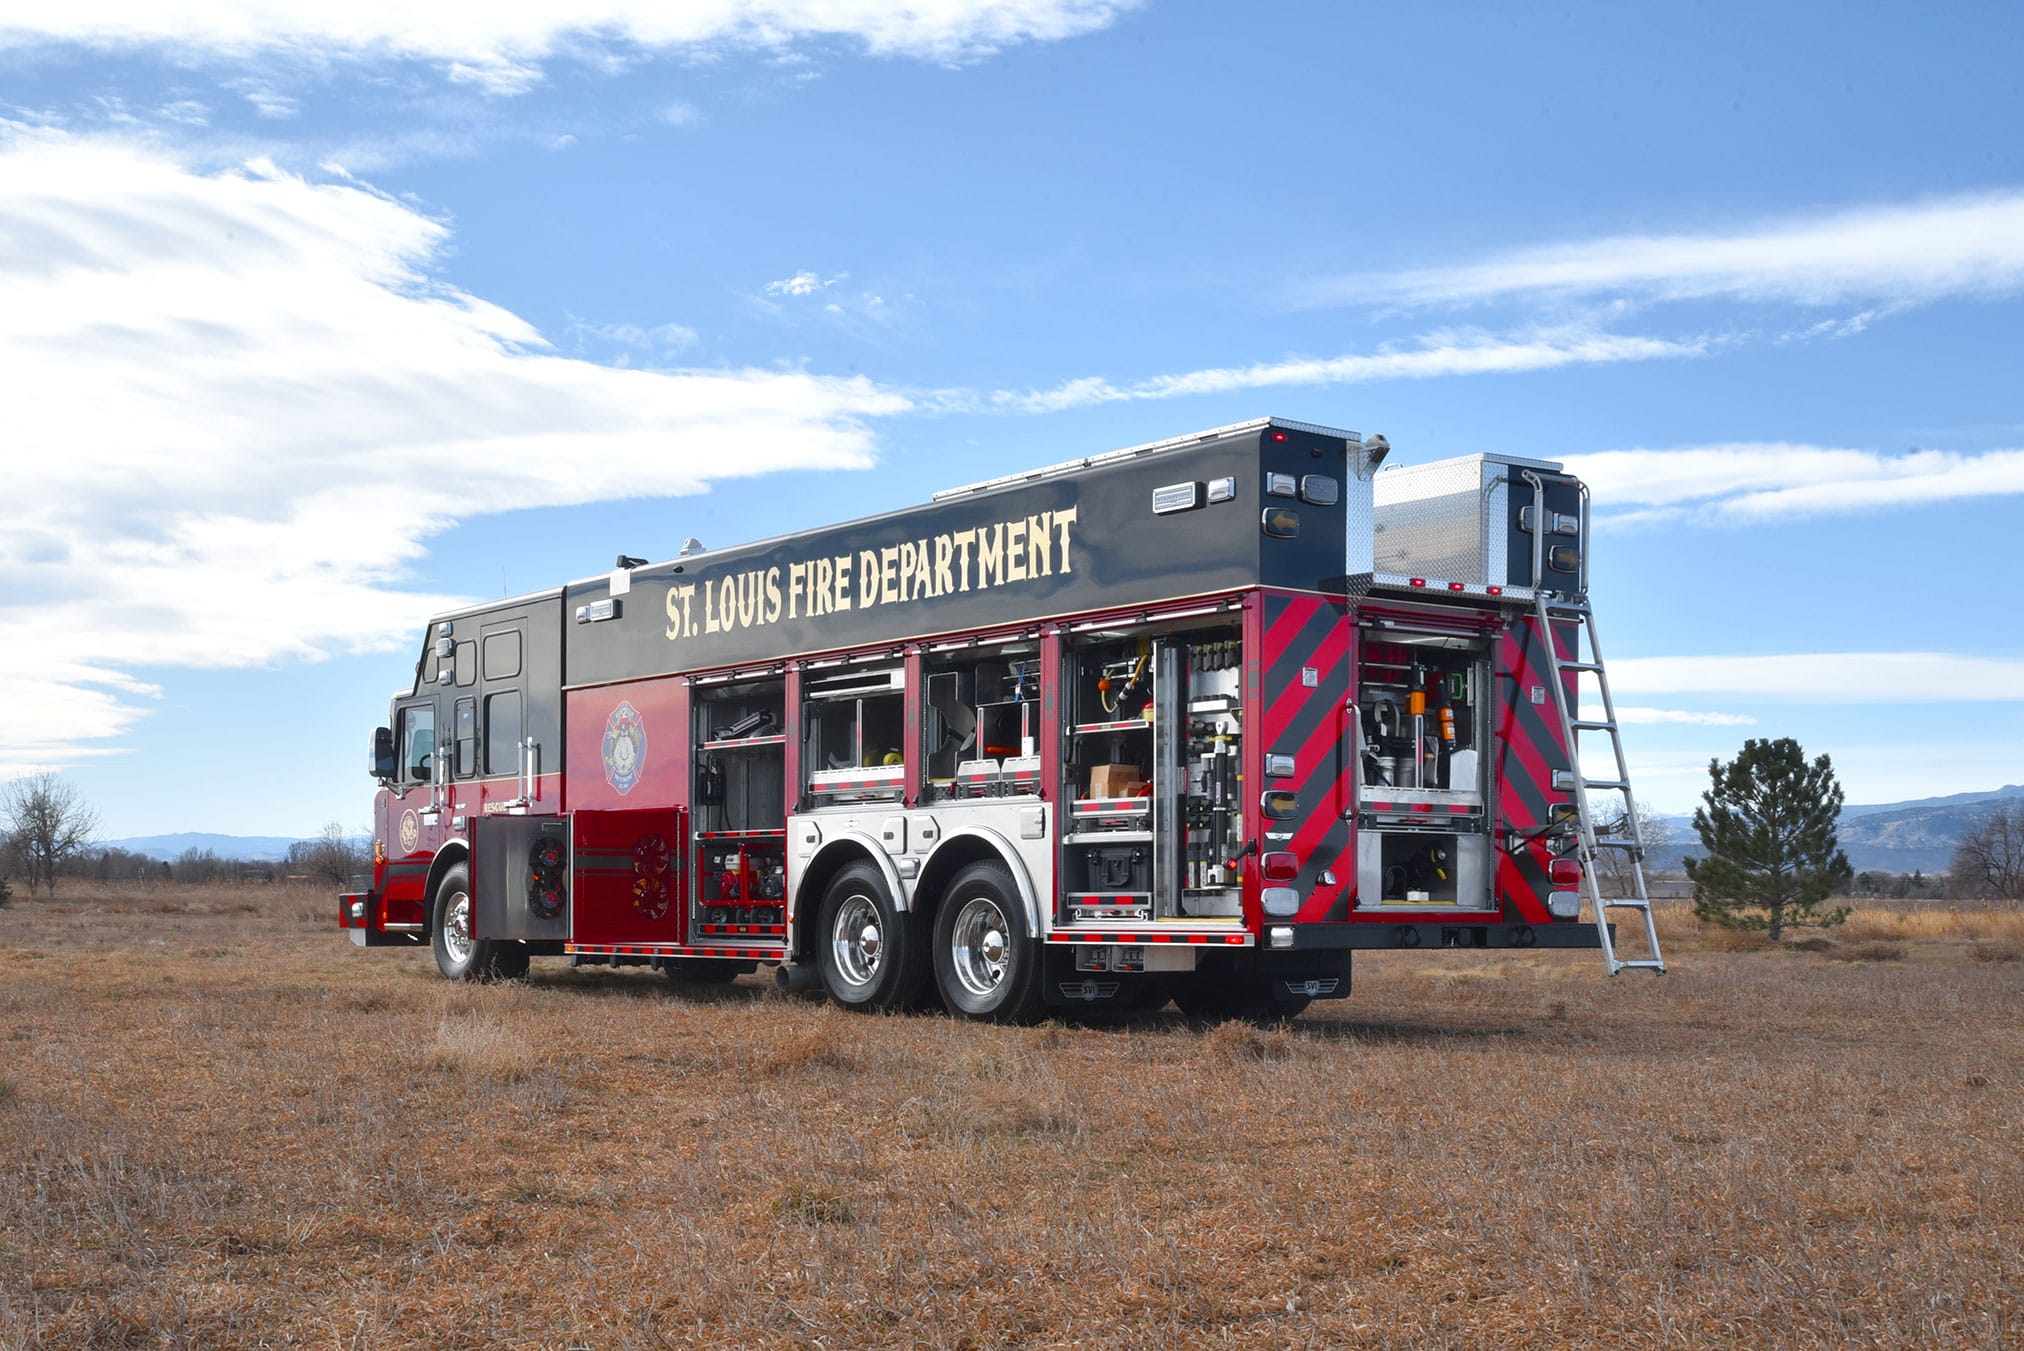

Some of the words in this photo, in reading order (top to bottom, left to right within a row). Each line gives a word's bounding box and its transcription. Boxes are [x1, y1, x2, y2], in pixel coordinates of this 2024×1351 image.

[665, 582, 699, 641] ST.
[705, 565, 782, 633] LOUIS
[788, 553, 852, 619] FIRE
[859, 504, 1078, 609] DEPARTMENT
